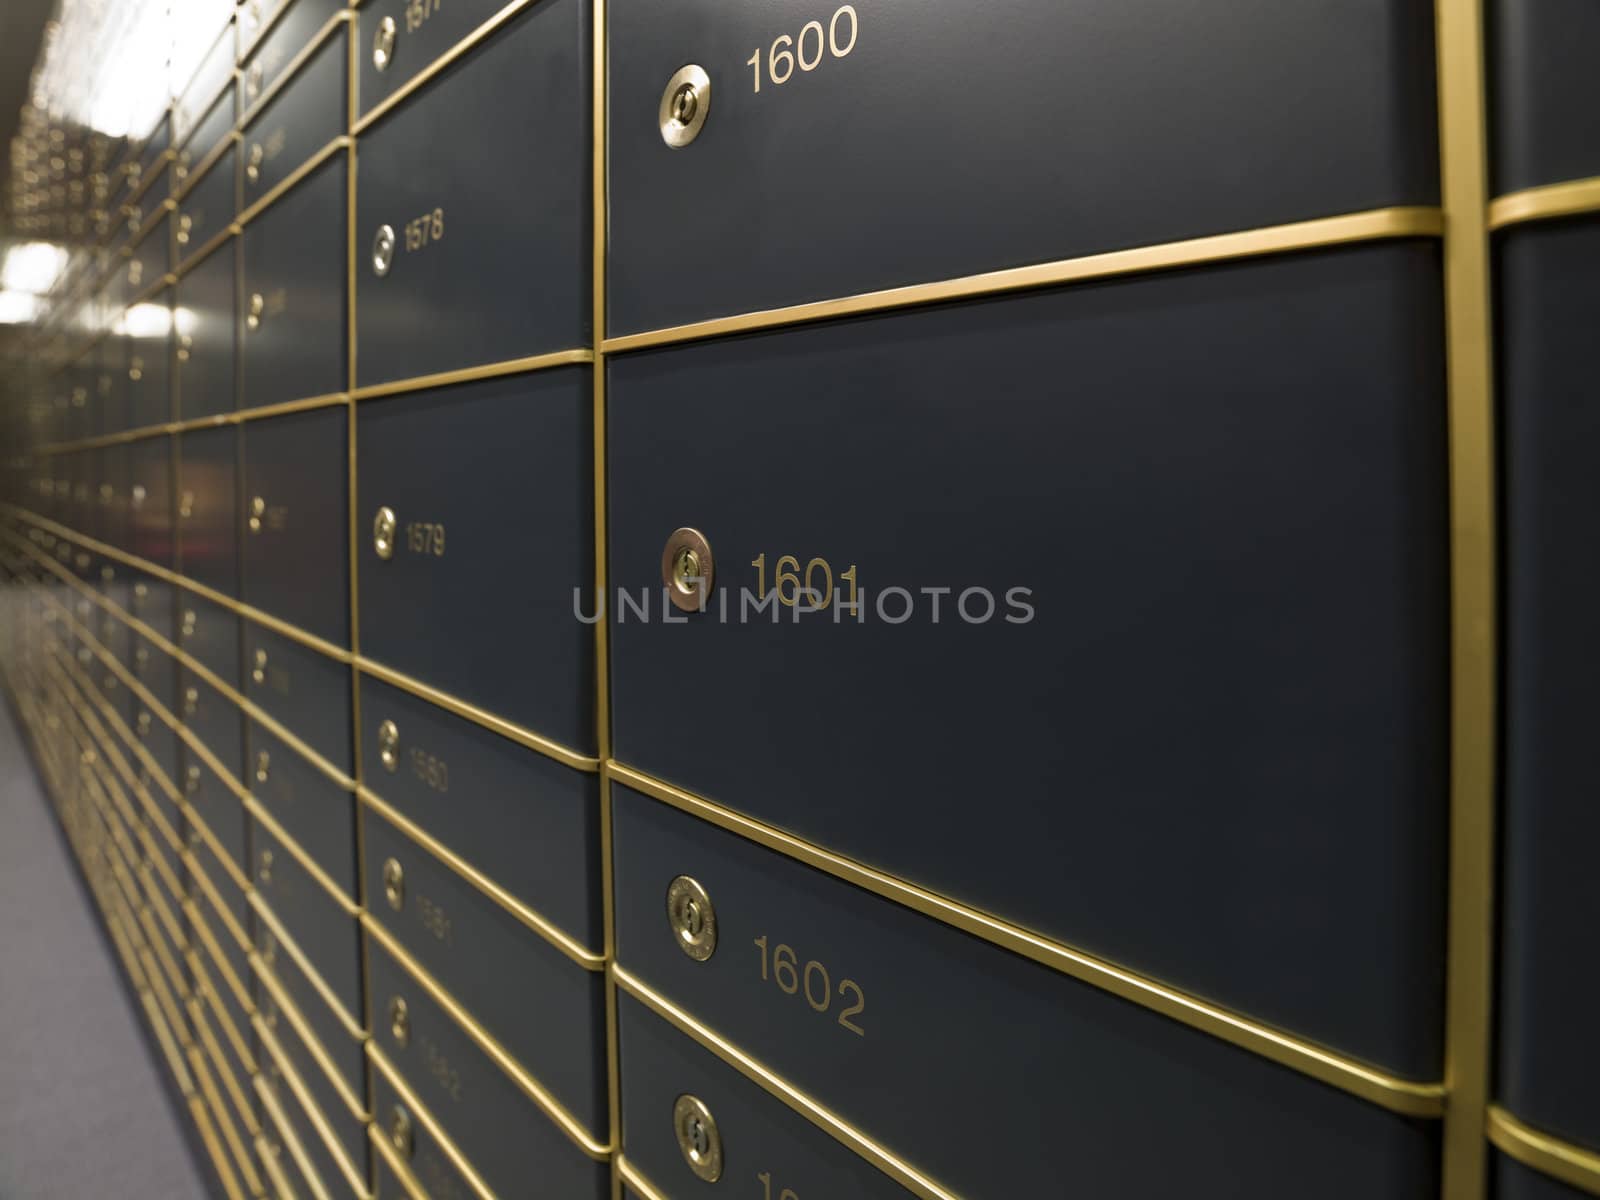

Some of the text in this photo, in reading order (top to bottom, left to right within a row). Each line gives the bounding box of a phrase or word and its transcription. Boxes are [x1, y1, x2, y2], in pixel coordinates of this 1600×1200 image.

[747, 5, 858, 93] 1600
[405, 207, 444, 252] 1578
[407, 522, 445, 556] 1579
[752, 553, 857, 616] 1601
[754, 936, 864, 1036] 1602
